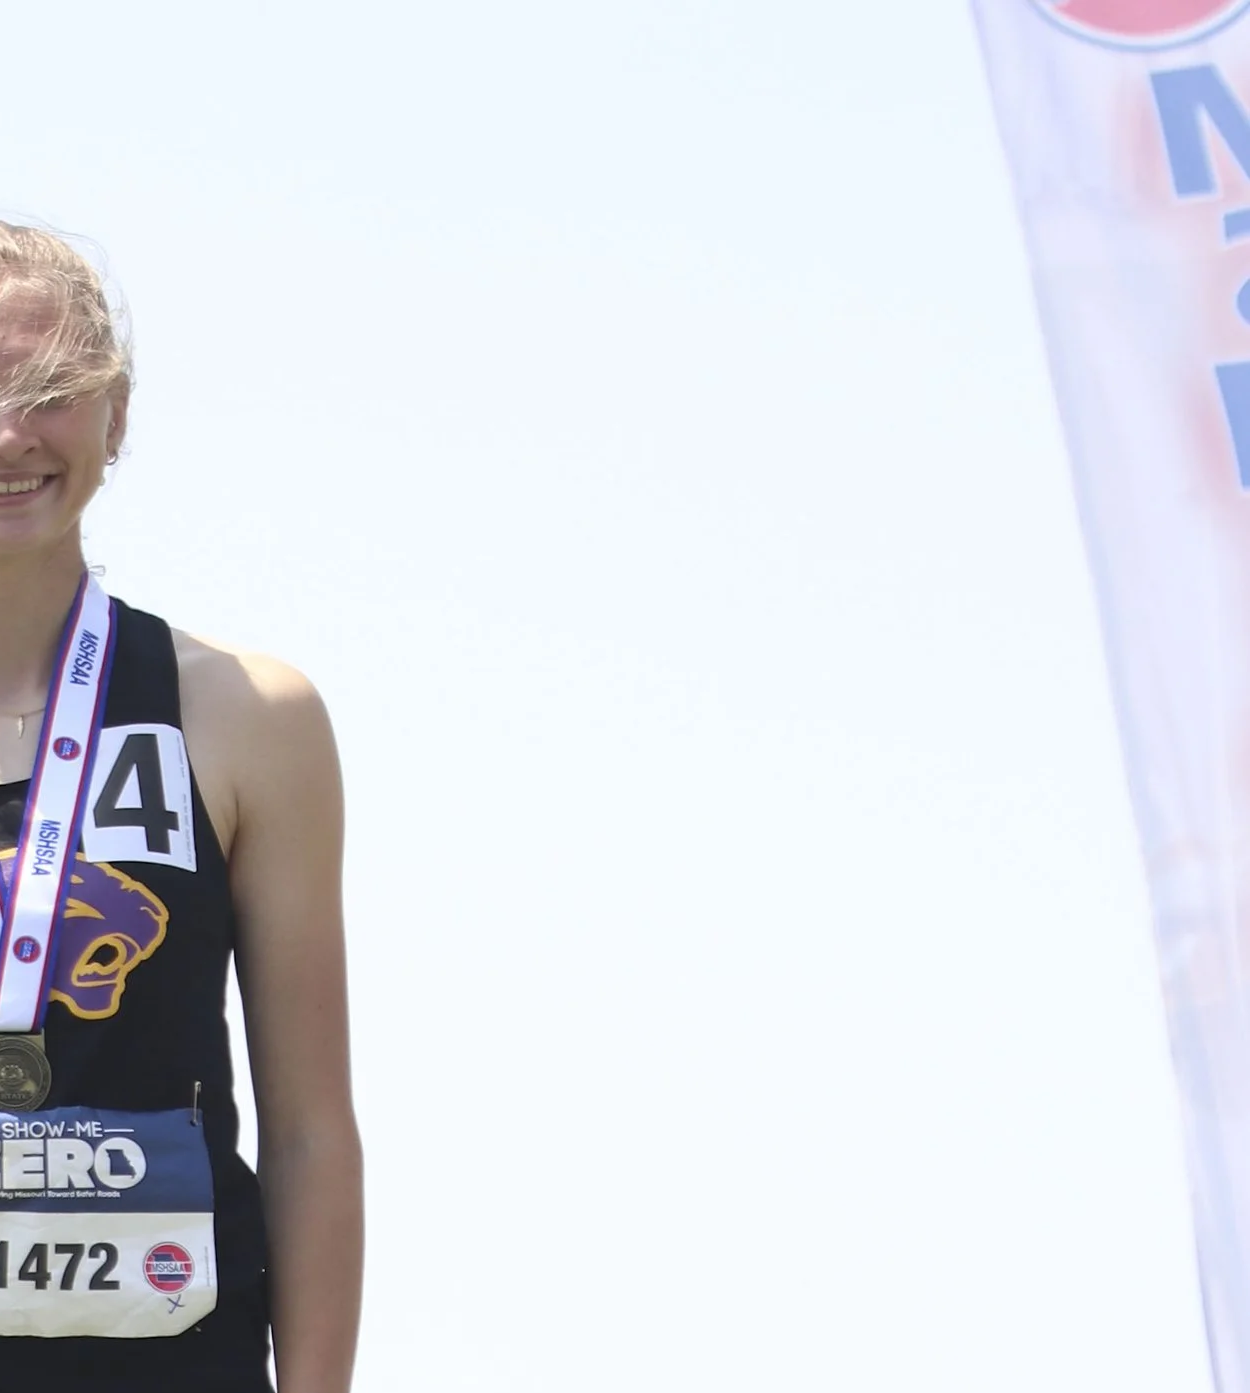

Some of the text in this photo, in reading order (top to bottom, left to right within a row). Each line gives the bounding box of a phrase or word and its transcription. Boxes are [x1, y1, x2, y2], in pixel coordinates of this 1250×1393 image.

[70, 629, 98, 686] MSHSAA
[93, 733, 179, 855] 4
[31, 819, 61, 876] MSHSAA
[1, 1121, 103, 1139] SHOW-ME
[14, 1190, 45, 1198] Missouri
[47, 1190, 75, 1198] Toward
[76, 1190, 96, 1198] Safer
[97, 1190, 121, 1198] Roads
[150, 1262, 185, 1274] MSHSAA
